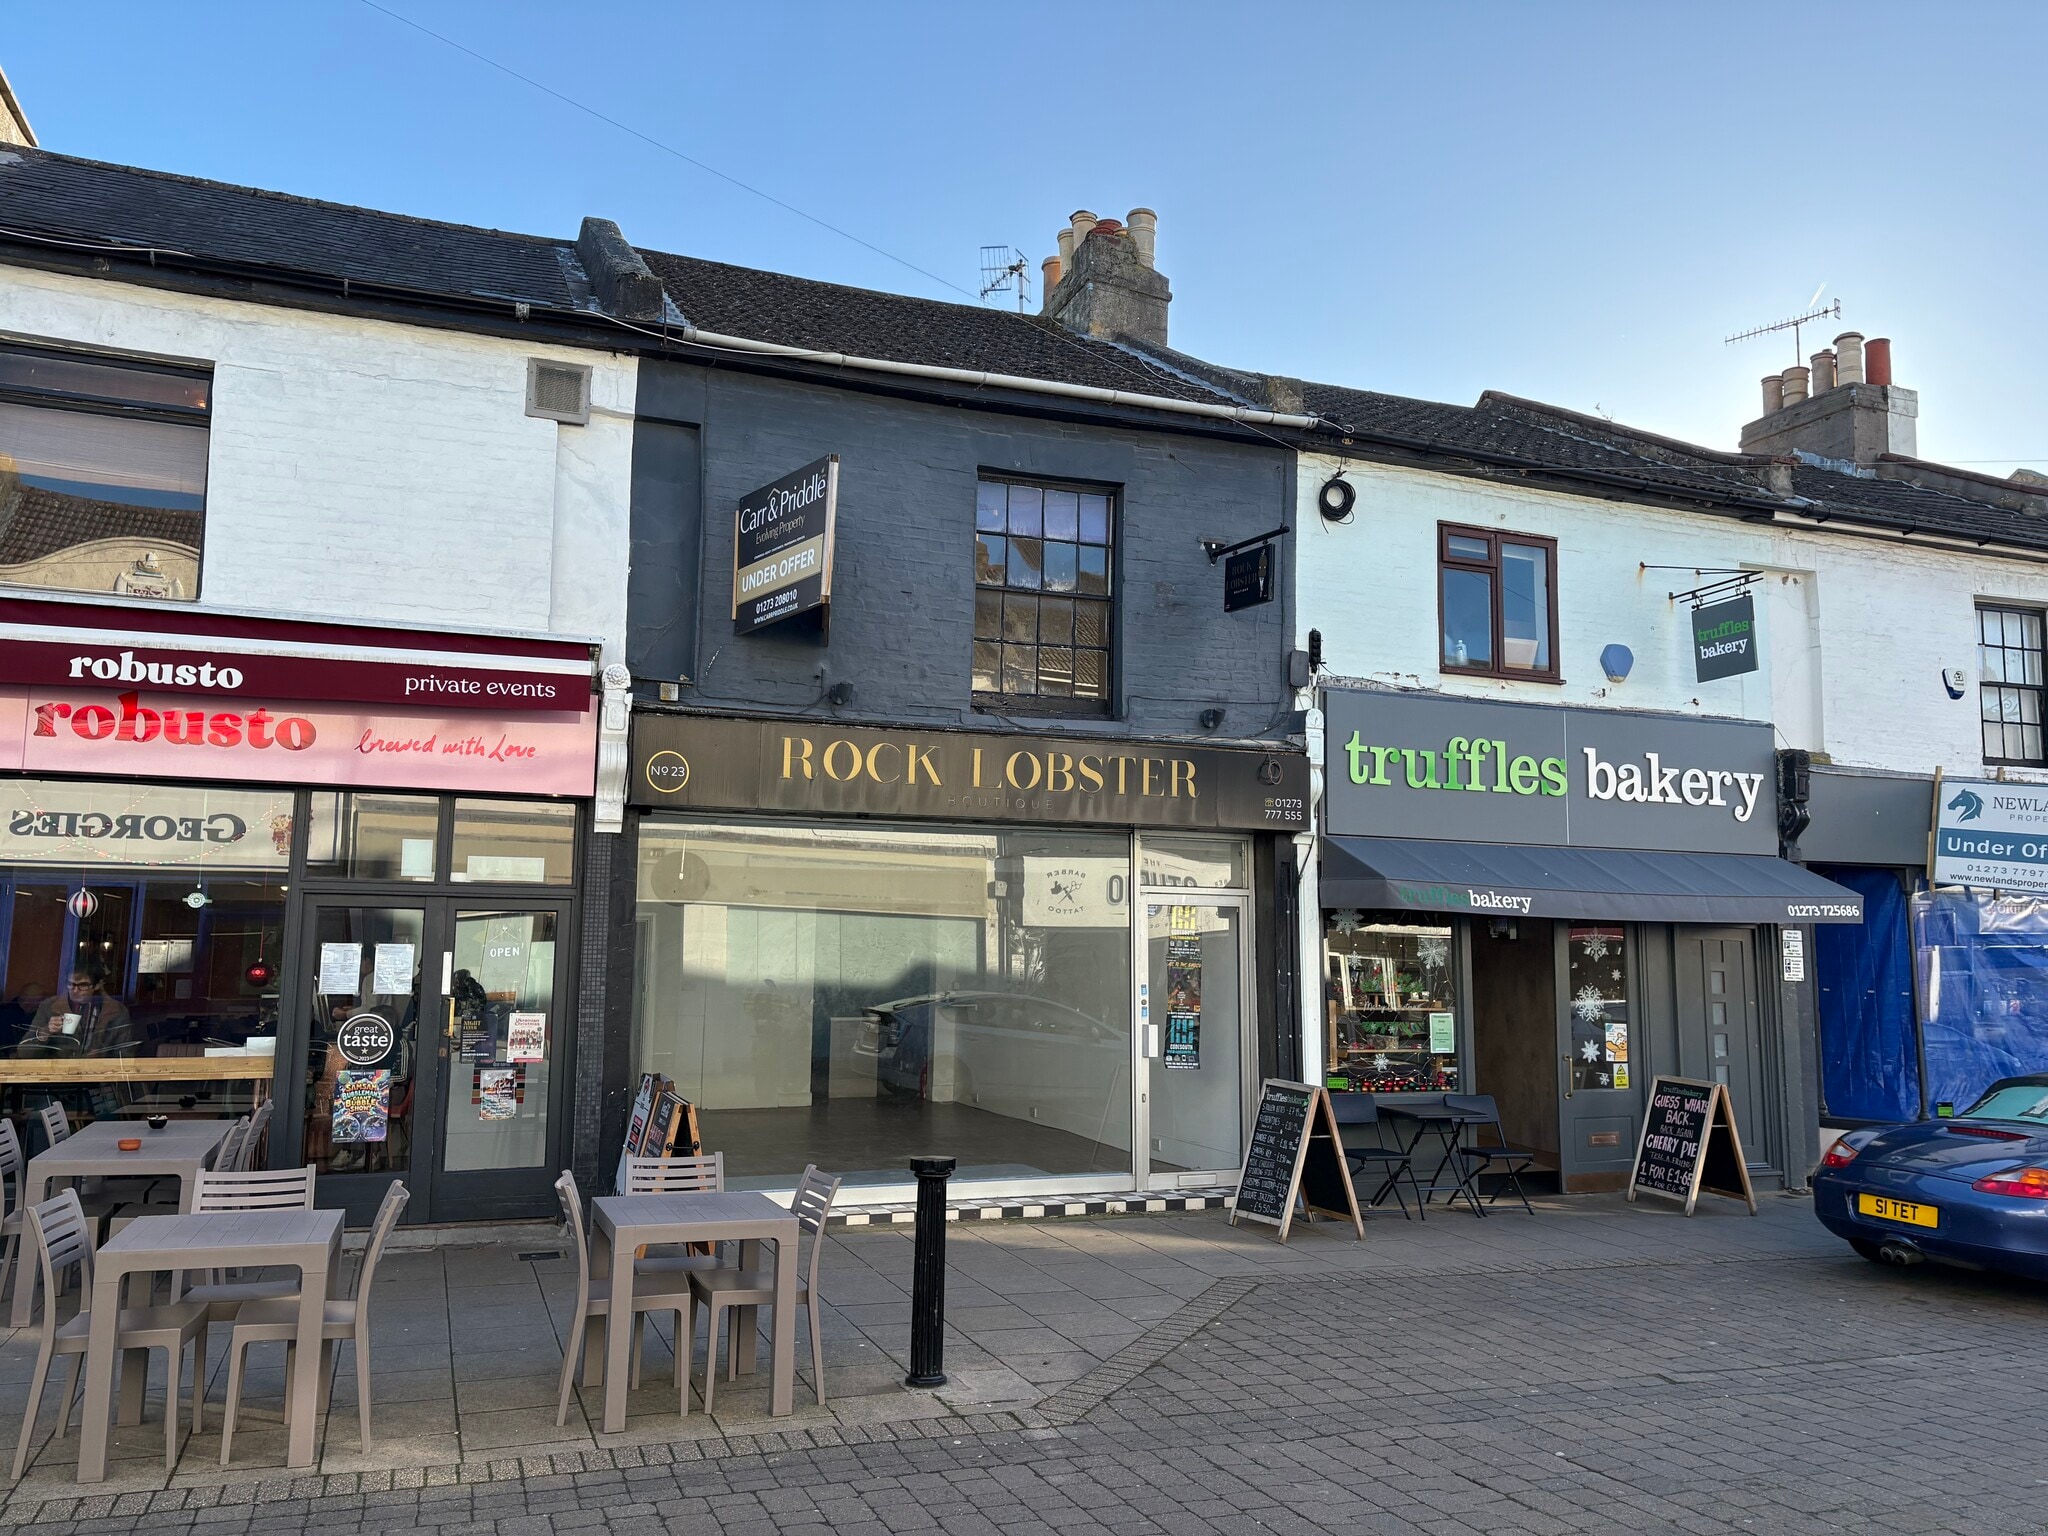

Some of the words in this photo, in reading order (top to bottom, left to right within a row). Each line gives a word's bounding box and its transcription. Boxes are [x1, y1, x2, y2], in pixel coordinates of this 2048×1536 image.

[755, 527, 779, 545] Evolving
[778, 514, 806, 537] Property
[742, 563, 777, 592] UNDER
[779, 548, 815, 577] OFFER
[755, 598, 774, 614] 01273
[774, 588, 798, 607] 208010
[1697, 620, 1750, 642] truffles
[1699, 638, 1748, 660] bakery
[68, 650, 244, 689] robusto
[404, 674, 481, 695] private
[486, 682, 556, 698] events
[32, 690, 317, 751] robusto
[354, 728, 437, 754] brewed
[442, 736, 485, 757] with
[671, 766, 686, 777] 23
[779, 736, 943, 786] ROCK
[971, 747, 1200, 799] LOBSTER
[1344, 730, 1569, 797] truffles
[1583, 747, 1764, 823] bakery
[947, 794, 1053, 811] BOUTIQUE
[1274, 798, 1302, 809] 01273
[1264, 809, 1282, 820] 777
[1284, 810, 1302, 821] 555
[1947, 836, 2015, 856] Under
[1967, 863, 2008, 875] 01273
[1787, 904, 1820, 917] 01273
[1820, 904, 1860, 917] 725686
[489, 946, 520, 958] OPEN
[343, 1033, 389, 1047] taste
[354, 1025, 379, 1036] great
[345, 1099, 376, 1108] BUBBLE
[1654, 1094, 1681, 1110] GUESS
[1646, 1134, 1680, 1153] CHERRY
[1680, 1140, 1698, 1159] PIE
[1639, 1161, 1647, 1176] 1
[1649, 1164, 1666, 1181] FOR
[1654, 1181, 1666, 1191] FOR
[1891, 1201, 1919, 1221] TET
